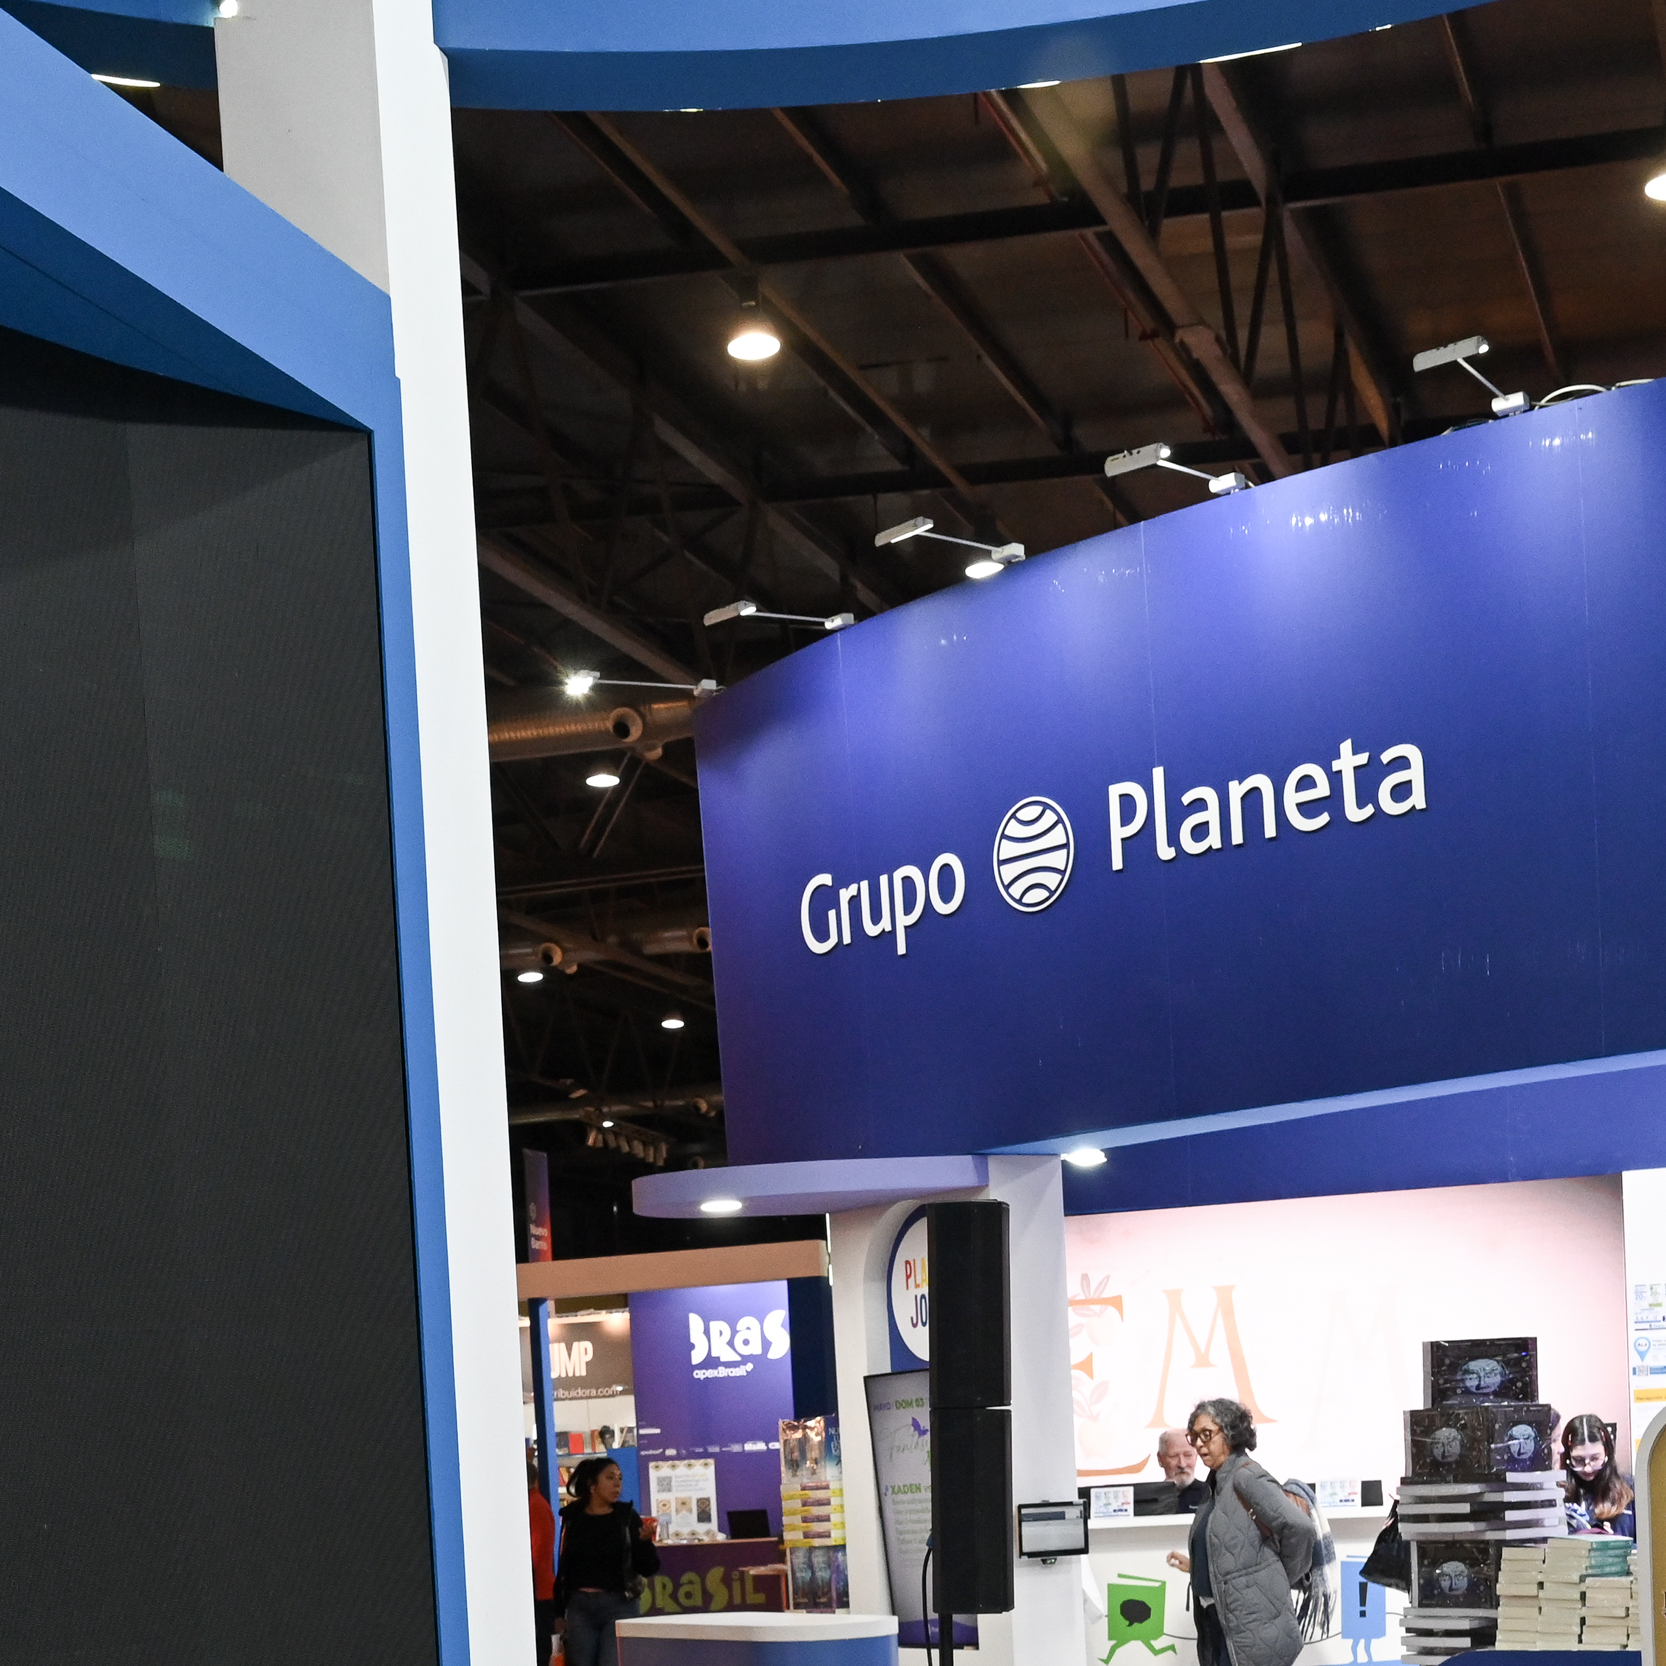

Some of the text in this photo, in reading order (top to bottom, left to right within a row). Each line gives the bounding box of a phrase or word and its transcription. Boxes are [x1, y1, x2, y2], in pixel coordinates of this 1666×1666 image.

[801, 738, 1427, 955] Grupo Planeta
[693, 1367, 747, 1380] apexBrasil
[891, 1482, 922, 1496] XADEN
